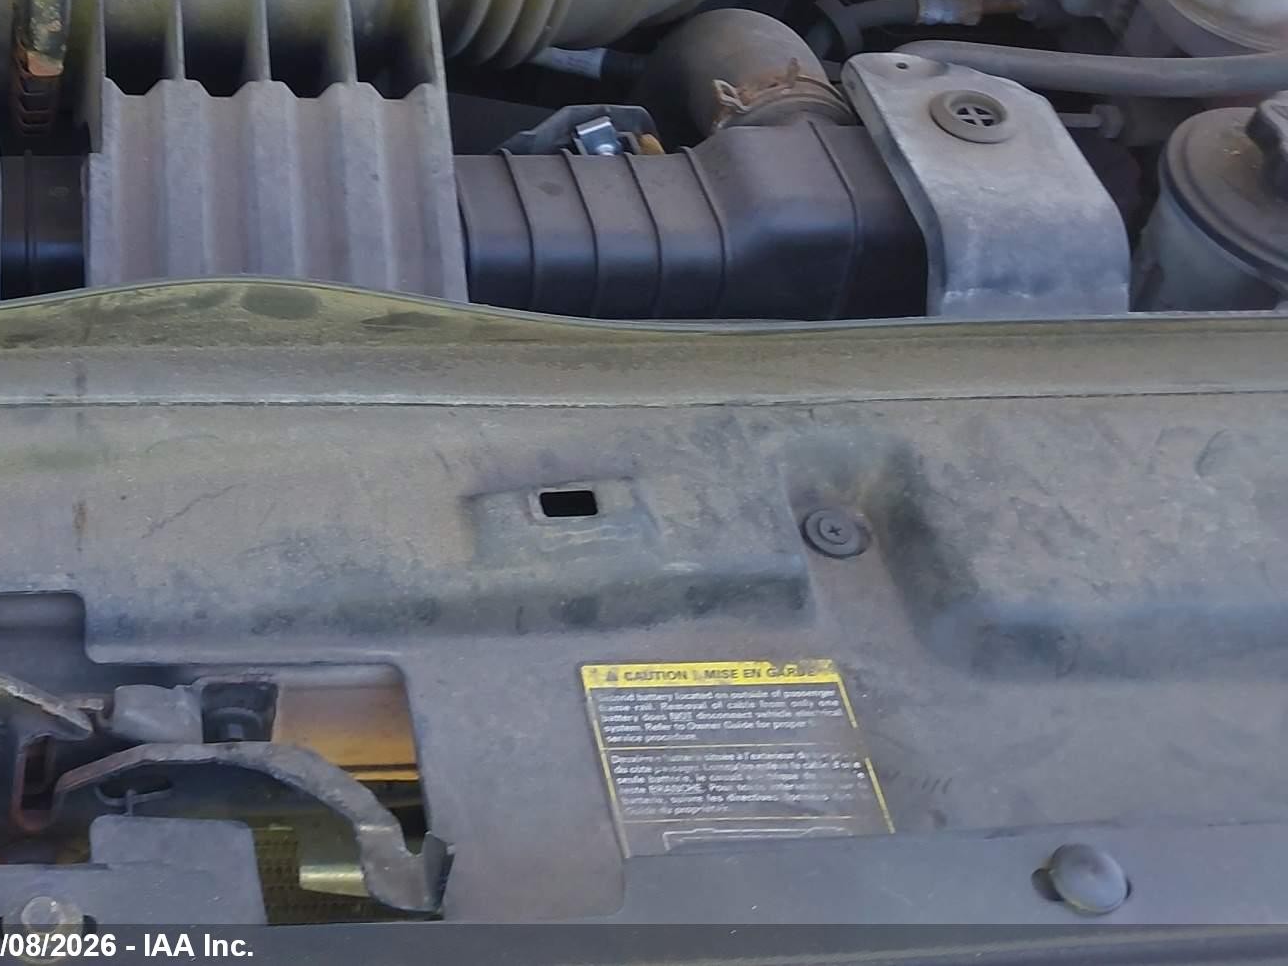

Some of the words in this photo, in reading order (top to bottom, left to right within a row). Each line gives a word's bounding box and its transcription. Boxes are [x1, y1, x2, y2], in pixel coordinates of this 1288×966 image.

[623, 670, 688, 681] CAUTION
[703, 668, 738, 679] MISE
[743, 667, 761, 678] EN
[674, 691, 713, 700] located
[770, 689, 782, 697] of
[783, 689, 836, 698] passenger
[660, 701, 708, 711] Removal
[726, 700, 756, 709] cable
[759, 699, 786, 708] from
[791, 699, 814, 709] only
[818, 699, 840, 707] one
[641, 713, 668, 722] does
[669, 712, 693, 722] NOT
[696, 711, 753, 720] disconnect
[644, 722, 672, 731] Refer
[686, 721, 721, 730] Owner
[723, 720, 754, 729] Guide
[773, 720, 808, 730] proper
[606, 734, 643, 742] service
